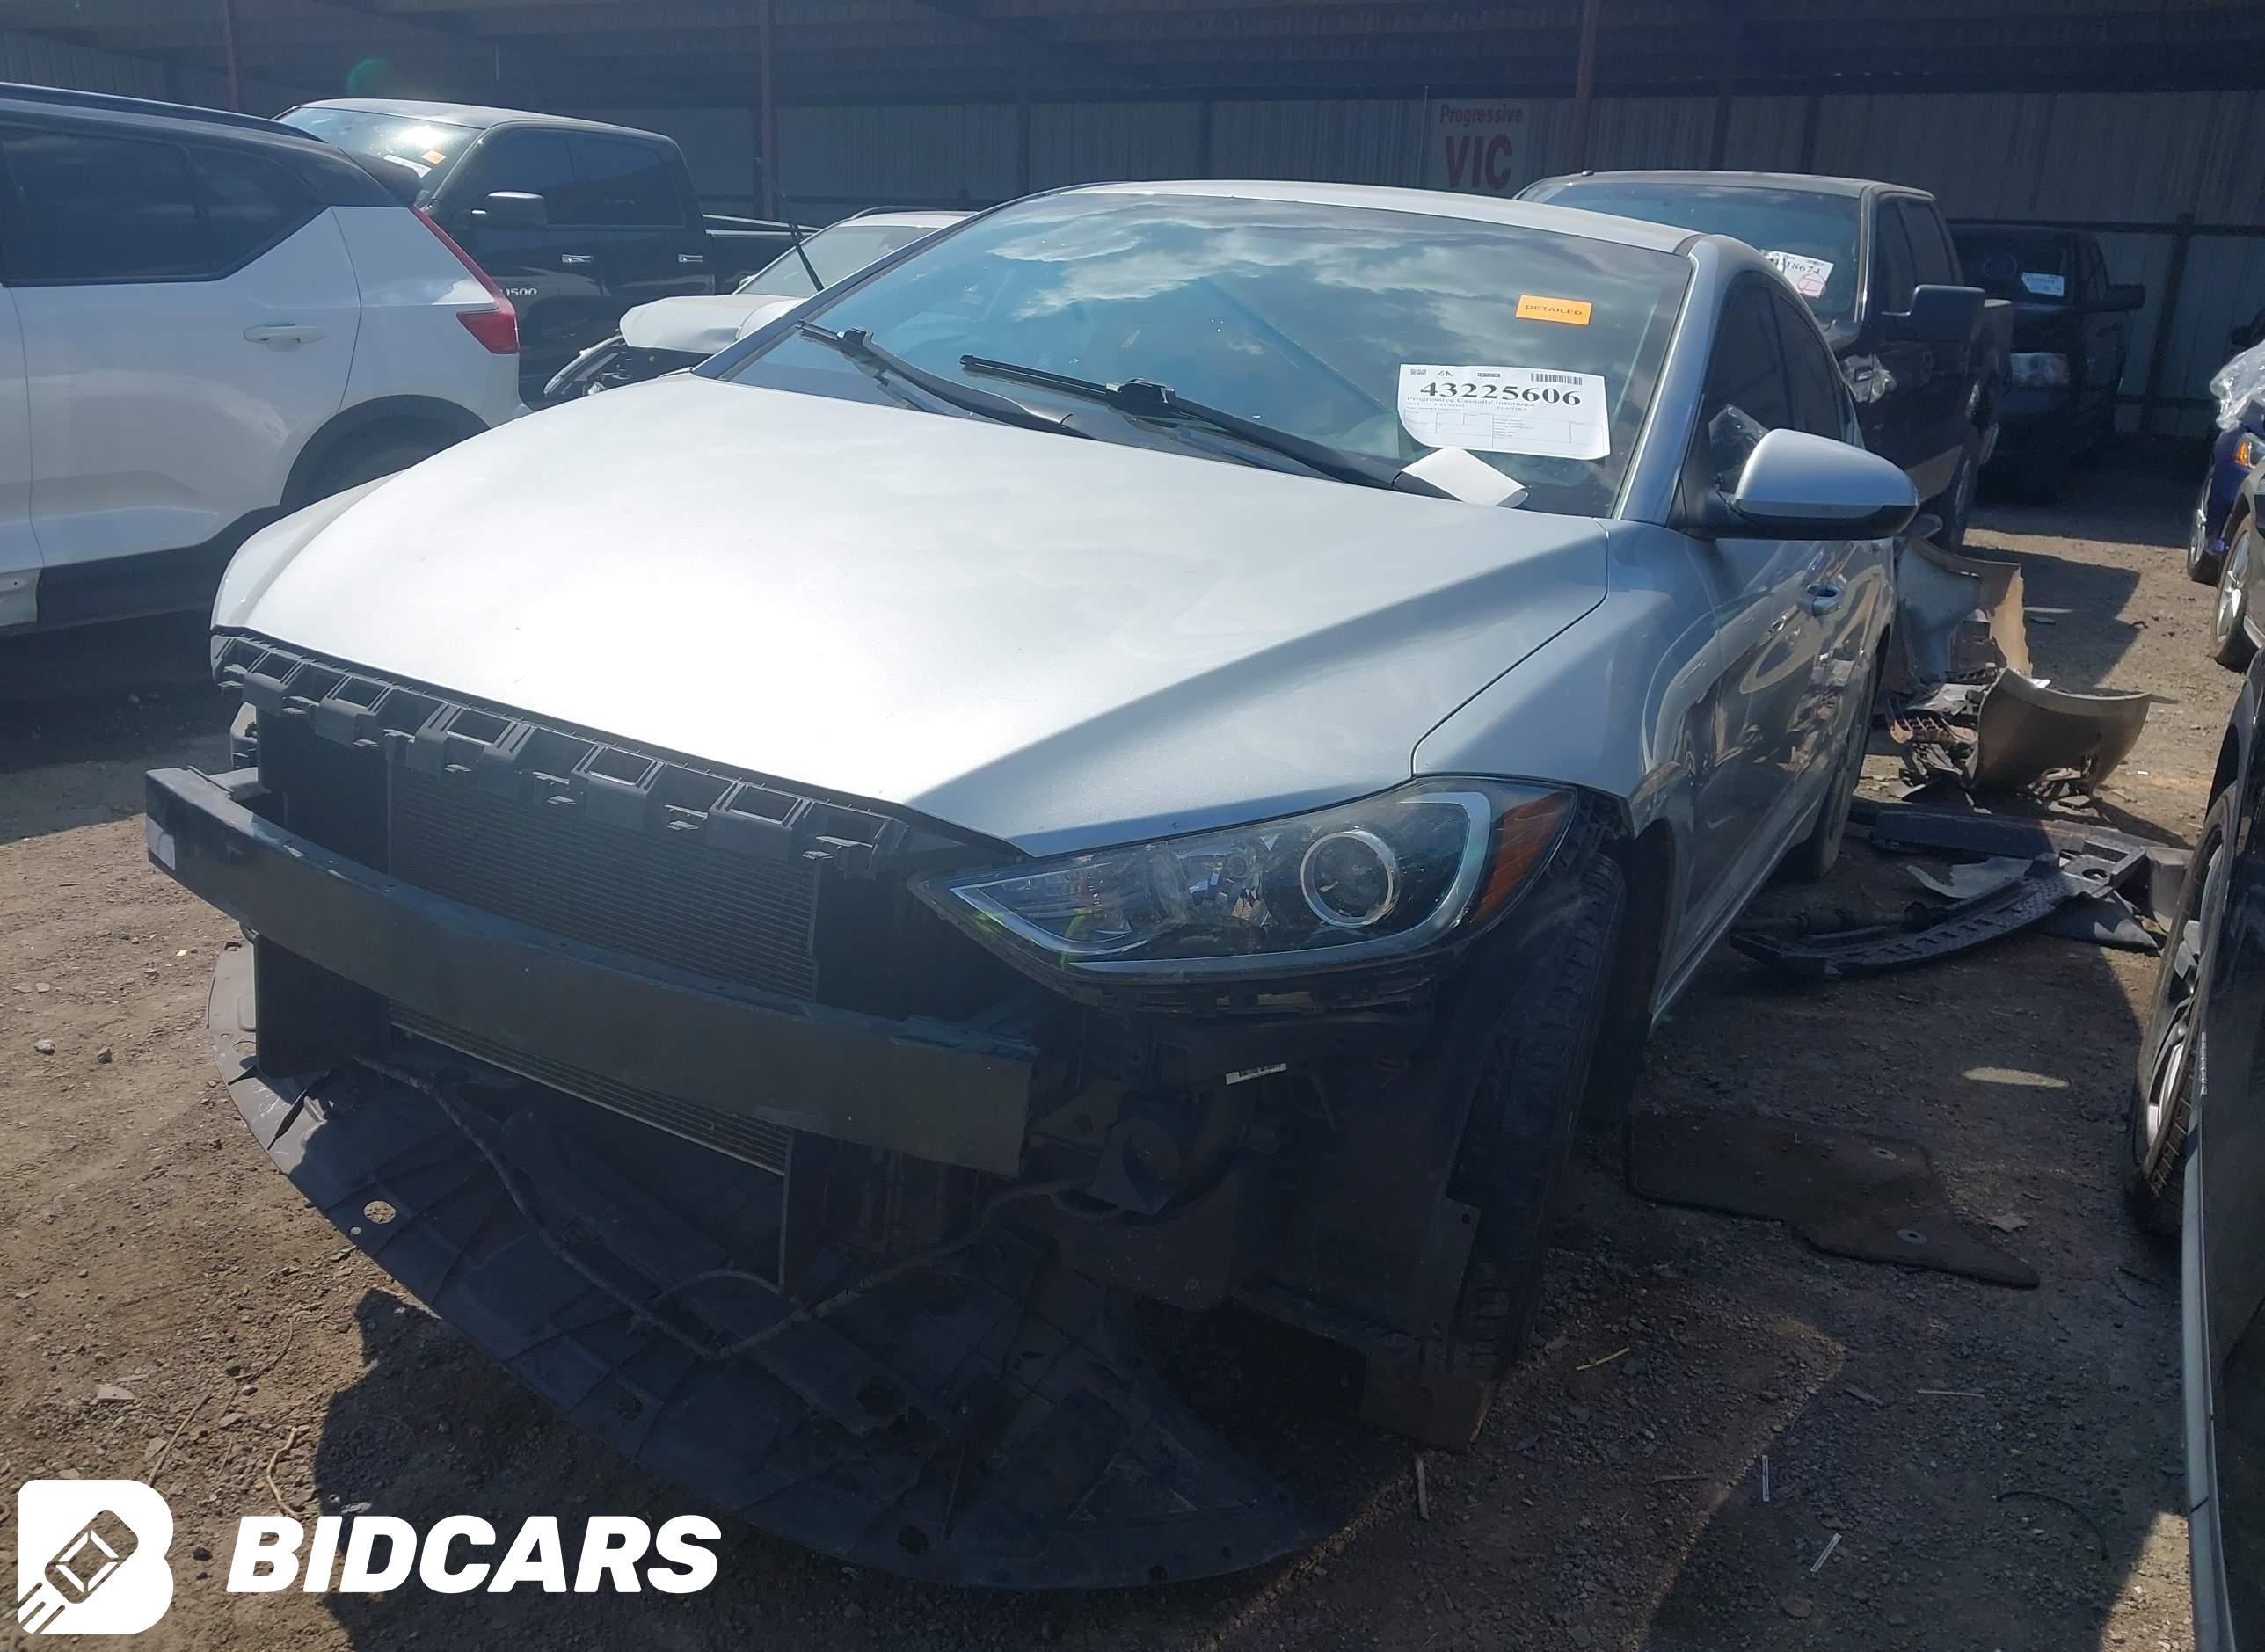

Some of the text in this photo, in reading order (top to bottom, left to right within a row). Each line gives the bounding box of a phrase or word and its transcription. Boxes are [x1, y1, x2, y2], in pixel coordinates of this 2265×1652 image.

[1440, 104, 1523, 127] Progressive
[1445, 134, 1513, 190] VIC
[506, 287, 537, 296] 1500
[1525, 304, 1583, 316] DETAILED
[1419, 382, 1582, 406] 43225606
